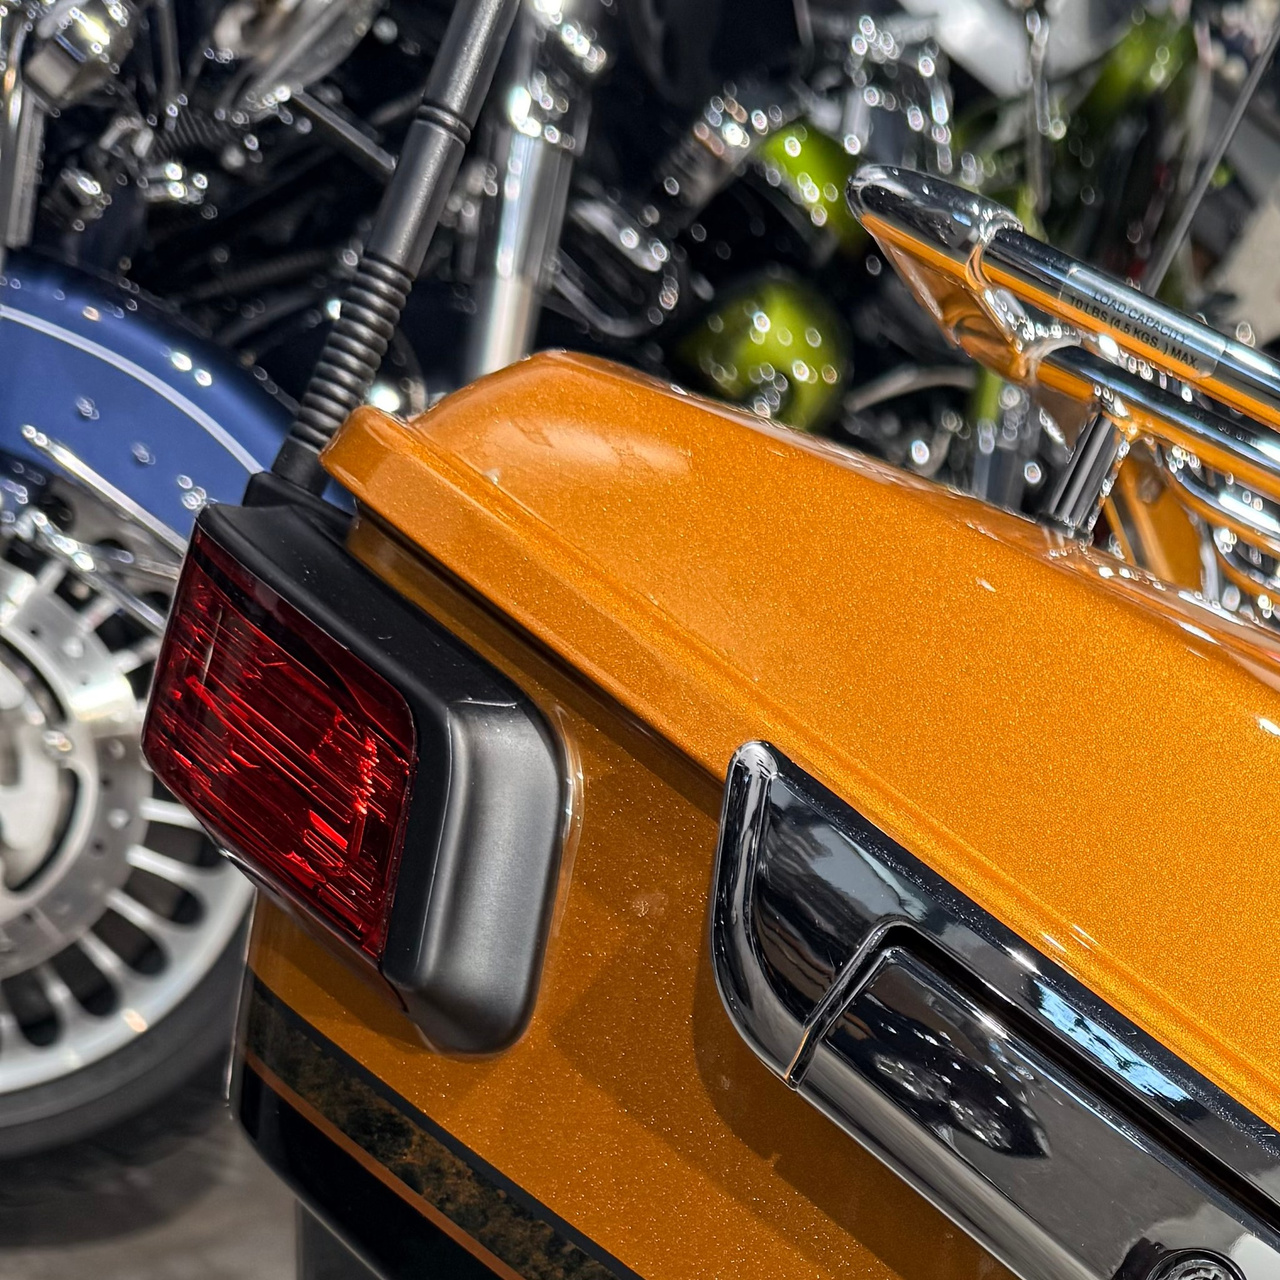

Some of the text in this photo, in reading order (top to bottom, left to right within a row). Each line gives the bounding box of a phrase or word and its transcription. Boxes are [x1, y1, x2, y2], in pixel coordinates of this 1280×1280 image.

[1084, 303, 1108, 323] LBS
[1109, 315, 1131, 335] (4.5
[1093, 291, 1188, 344] LOAD CAPACITY
